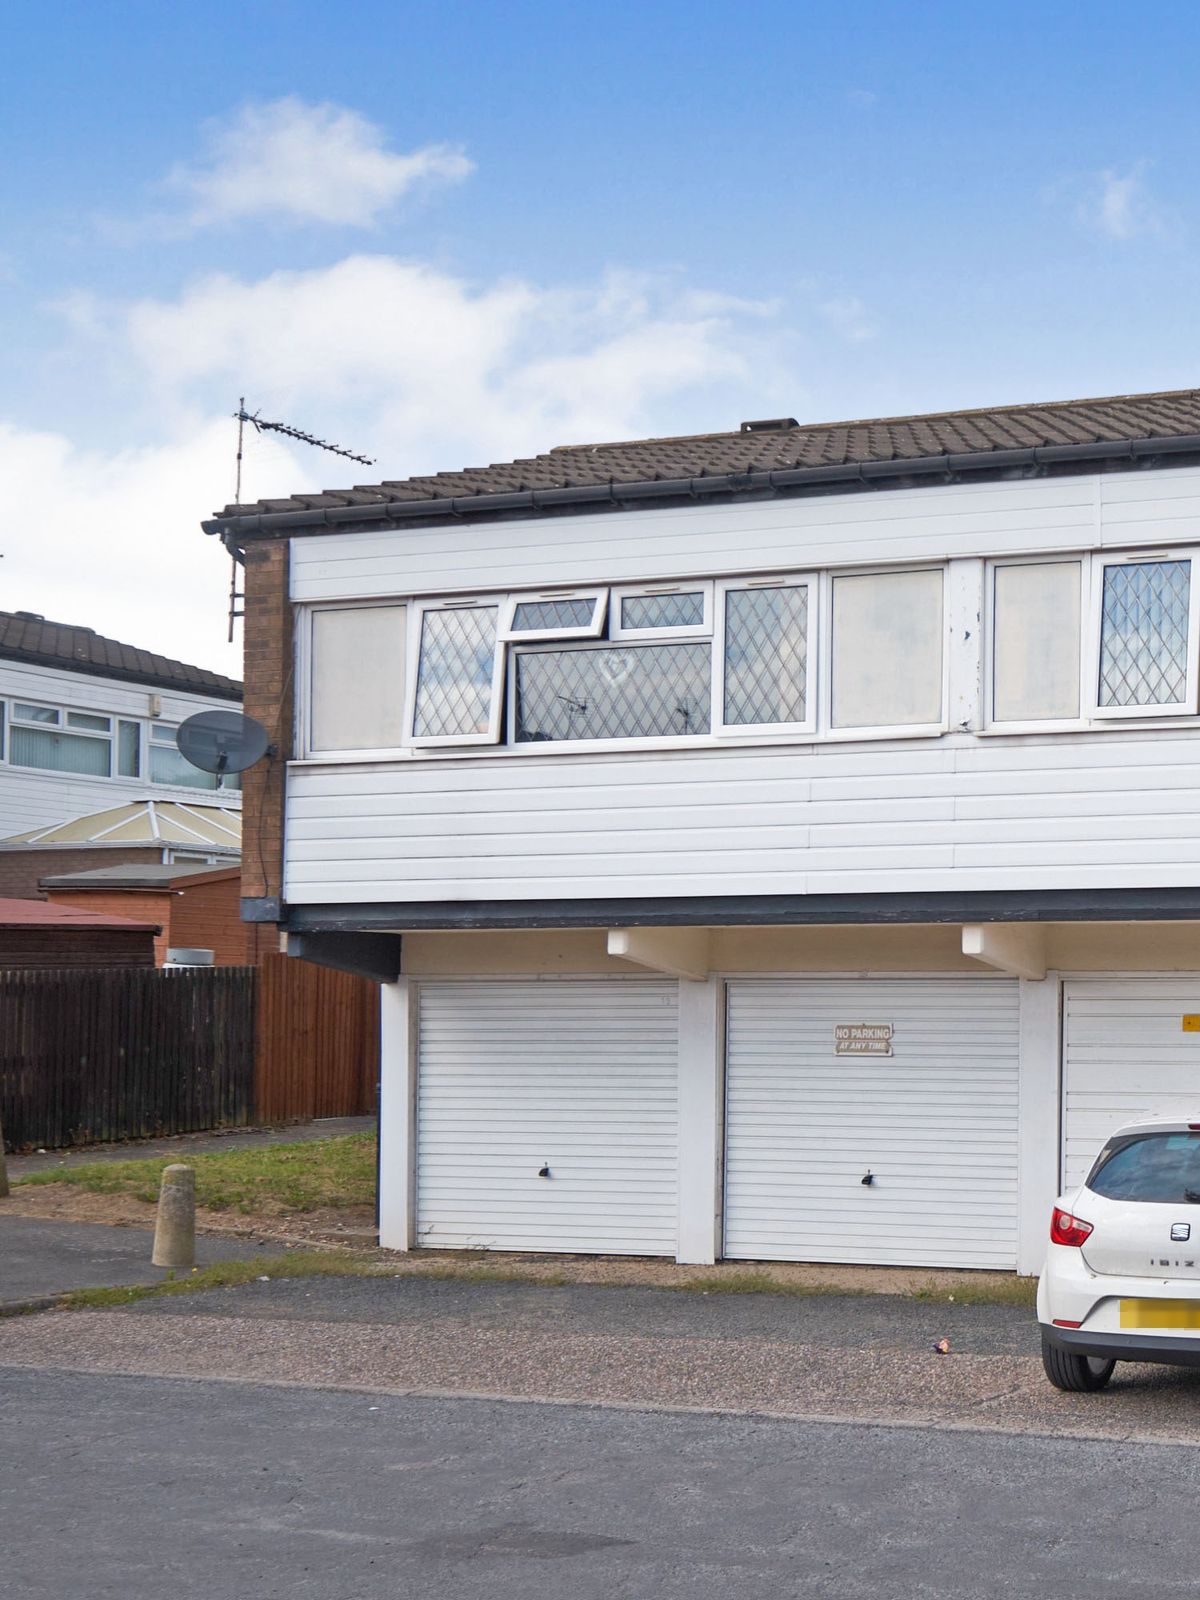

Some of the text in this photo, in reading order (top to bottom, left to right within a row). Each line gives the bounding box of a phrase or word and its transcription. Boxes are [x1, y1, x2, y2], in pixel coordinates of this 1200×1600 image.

[836, 1028, 890, 1039] NO PARKING
[868, 1042, 888, 1050] TIME
